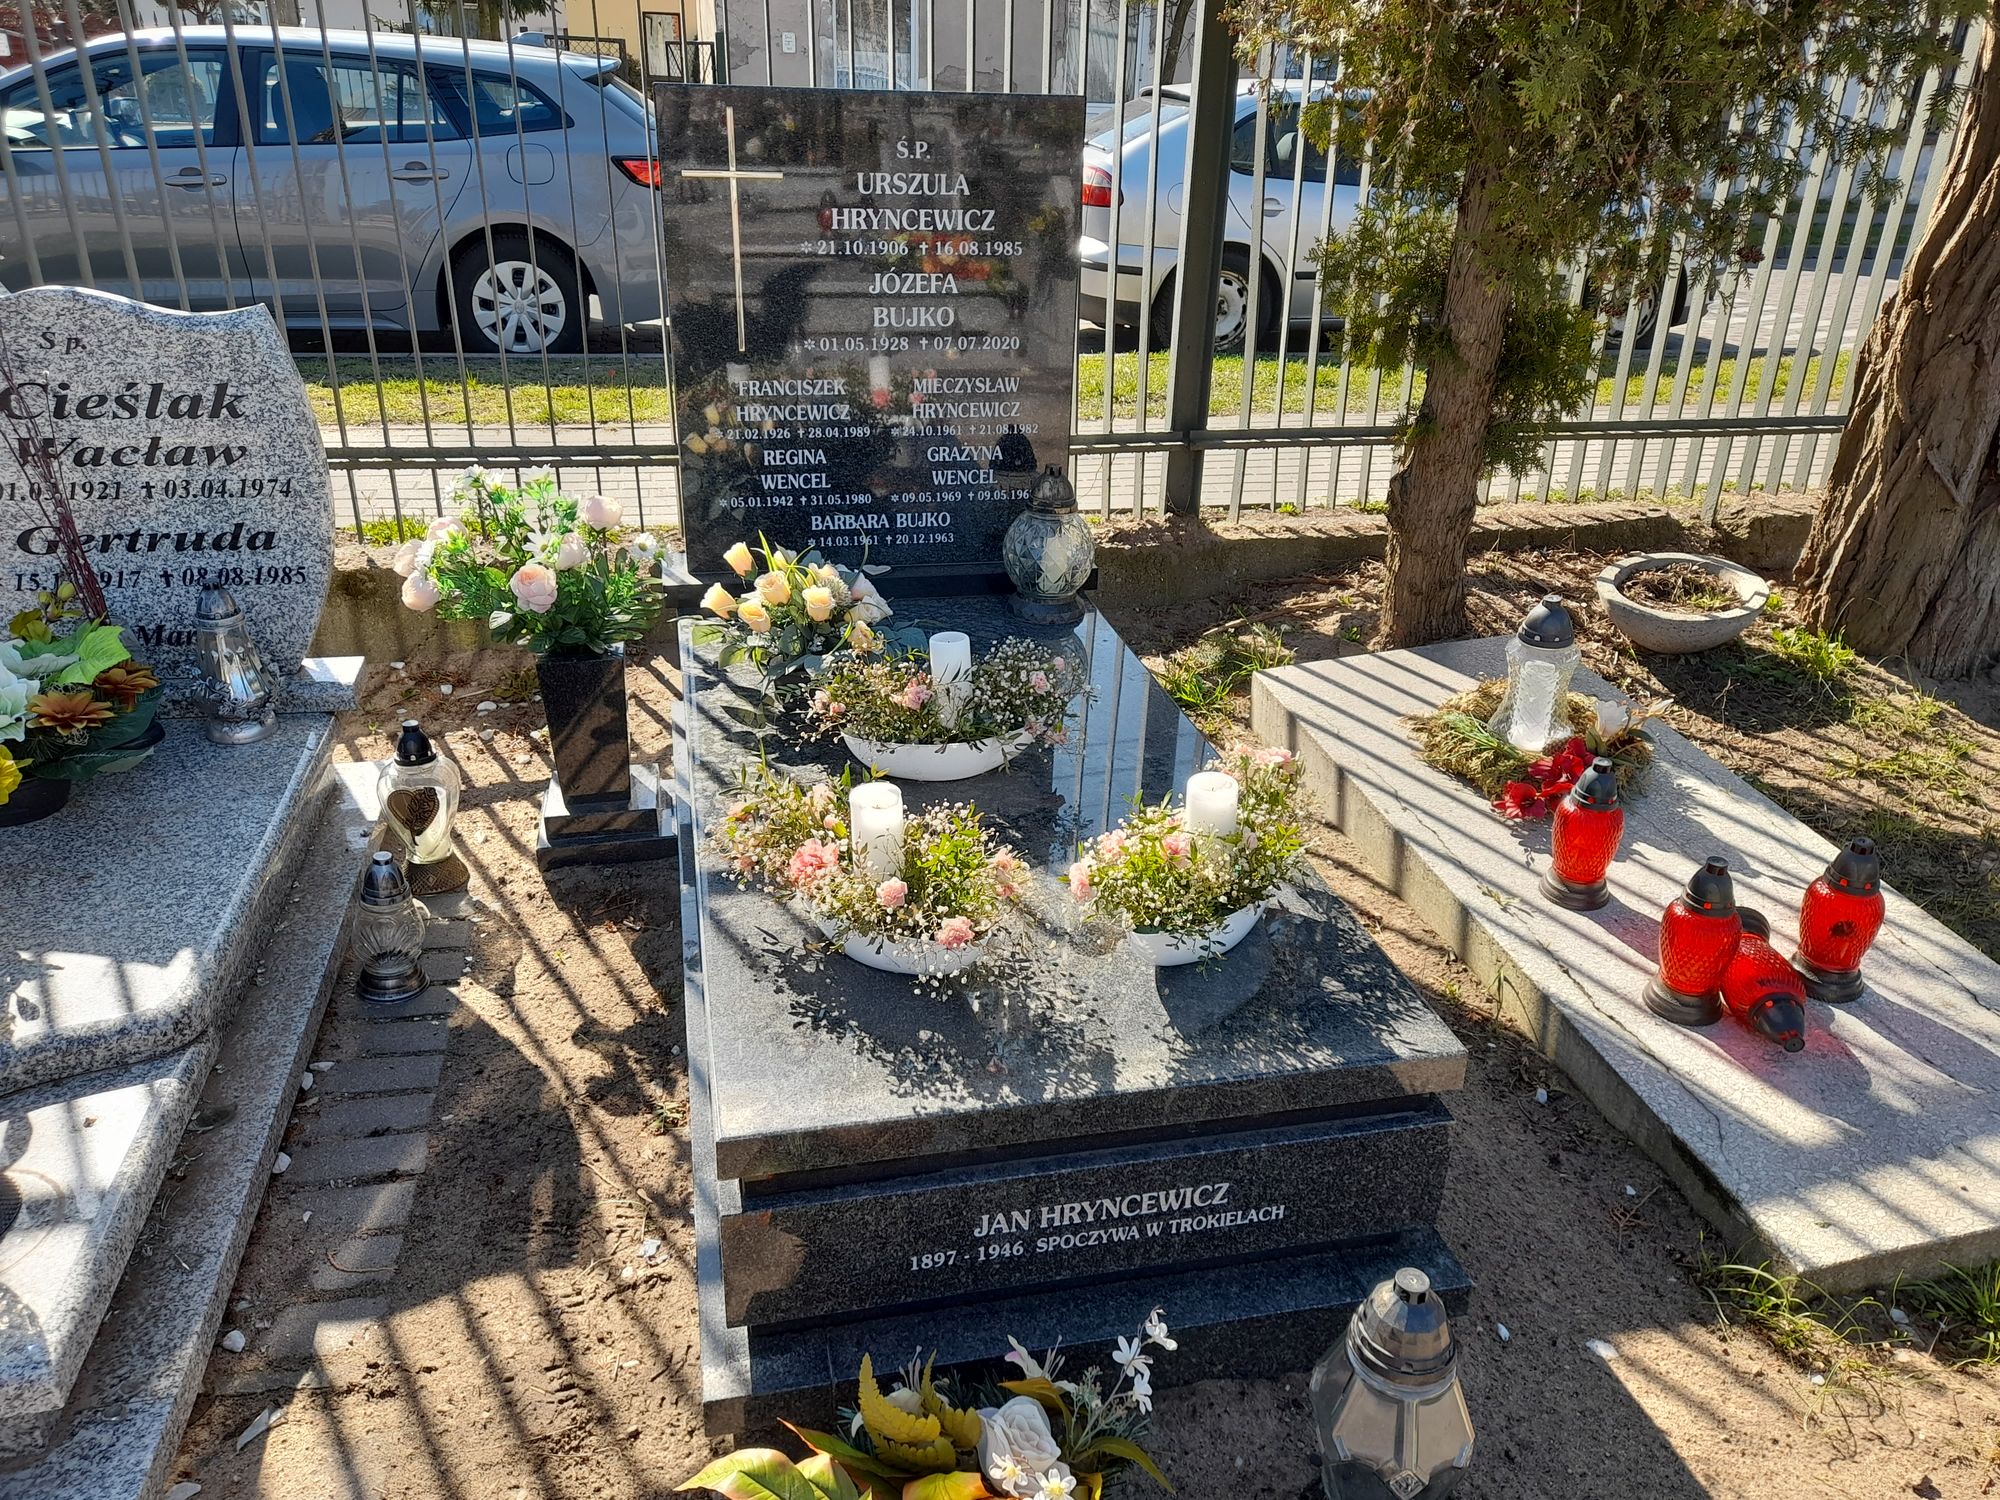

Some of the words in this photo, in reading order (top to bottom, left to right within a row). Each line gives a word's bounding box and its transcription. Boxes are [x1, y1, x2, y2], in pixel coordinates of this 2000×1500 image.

[896, 136, 931, 160] Ś.P.
[857, 173, 971, 197] URSZULA
[831, 208, 996, 232] HRYNCEWICZ
[817, 240, 909, 256] 21.10.1906
[936, 241, 1023, 257] 16.08.1985
[868, 267, 959, 294] JÓZEFA
[873, 306, 955, 328] BUJKO
[819, 337, 909, 352] 01.05.1928
[933, 336, 1020, 351] 07.07.2020
[738, 378, 847, 397] FRANCISZEK
[912, 376, 1021, 394] MIECZYSŁAW
[0, 382, 251, 420] Cieślak
[912, 401, 1021, 419] HRYNCEWICZ
[735, 404, 851, 422] HRYNCEWICZ
[727, 428, 791, 440] 21.02.1926
[808, 426, 871, 439] 28.04.1989
[902, 425, 962, 437] 24.10.1961
[979, 423, 1039, 435] 21.08.1982
[10, 437, 250, 468] Wacław
[763, 449, 827, 466] REGINA
[927, 442, 1004, 462] GRAŻYNA
[761, 473, 831, 490] WENCEL
[932, 469, 998, 485] WENCEL
[164, 477, 293, 500] 03.04.1974
[902, 491, 962, 503] 09.05.1969
[977, 489, 1032, 501] 09.05.196
[730, 495, 794, 508] 05.01.1942
[810, 494, 872, 506] 31.05.1980
[811, 513, 889, 531] BARBARA
[896, 511, 951, 528] BUJKO
[16, 522, 278, 556] Gertruda
[820, 534, 879, 547] 14.03.1961
[895, 532, 954, 545] 20.12.1963
[973, 1208, 1031, 1238] JAN
[1040, 1182, 1230, 1229] HRYNCEWICZ
[910, 1249, 957, 1271] 1897
[977, 1240, 1024, 1262] 1946
[1036, 1226, 1140, 1254] SPOCZYWA
[1146, 1220, 1164, 1238] W
[1169, 1204, 1285, 1235] TROKIELACH
